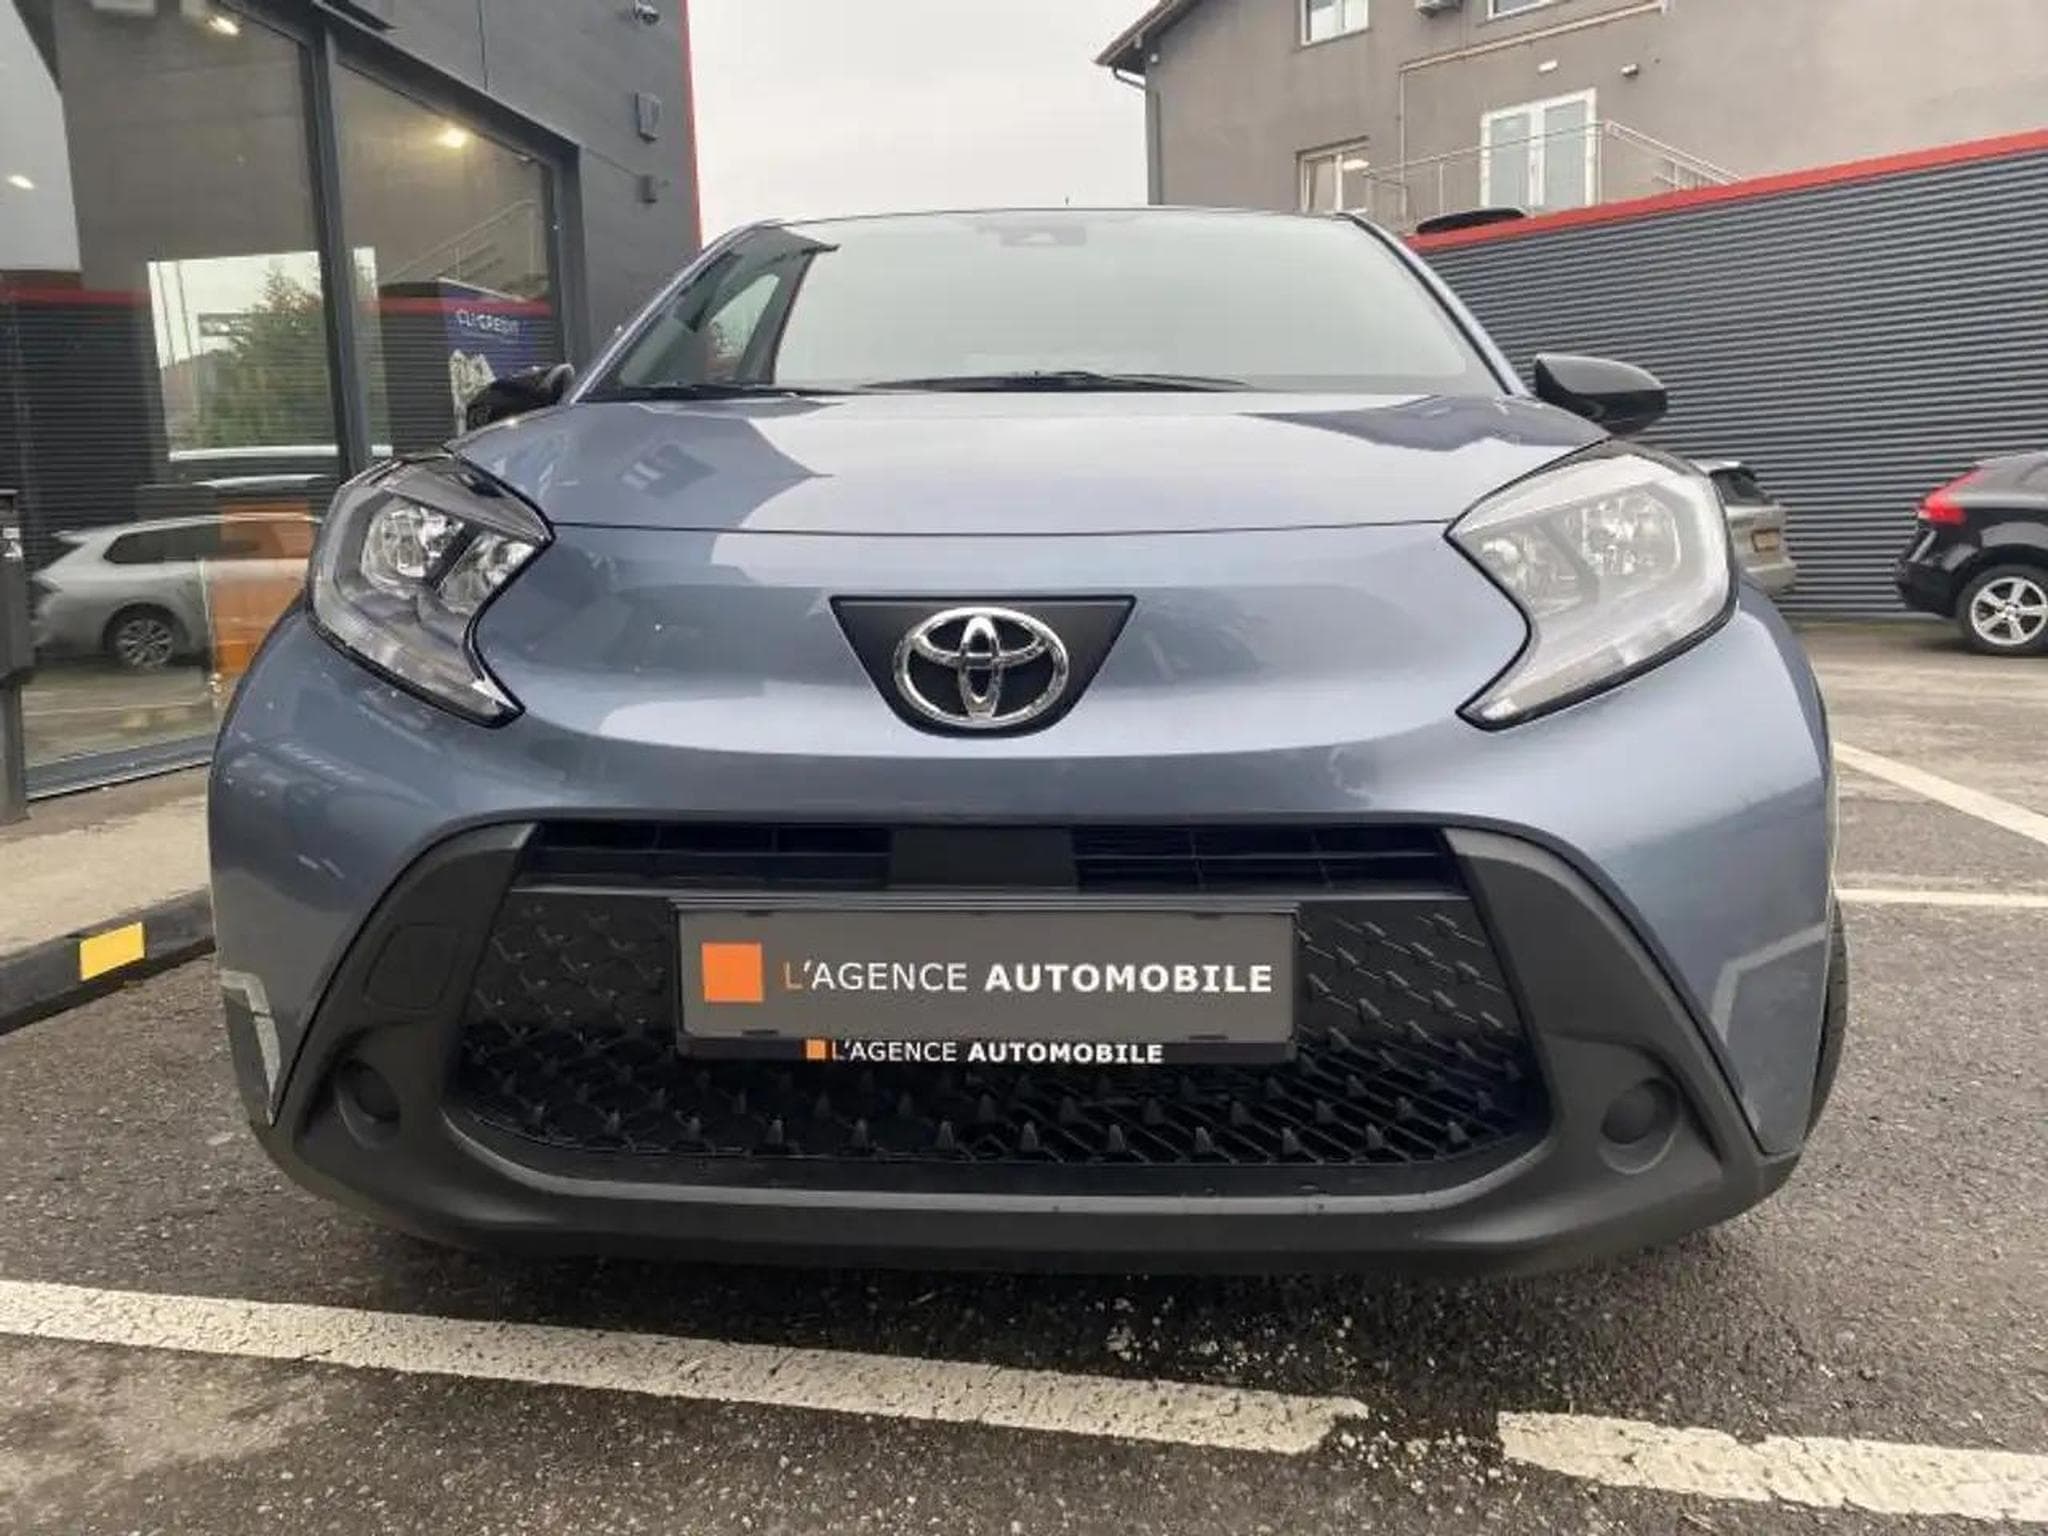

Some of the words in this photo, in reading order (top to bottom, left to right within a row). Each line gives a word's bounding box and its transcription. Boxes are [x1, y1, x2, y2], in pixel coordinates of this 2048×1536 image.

[783, 960, 967, 991] L'AGENCE
[984, 963, 1272, 993] AUTOMOBILE
[832, 1041, 957, 1062] L'AGENCE
[967, 1042, 1164, 1064] AUTOMOBILE
